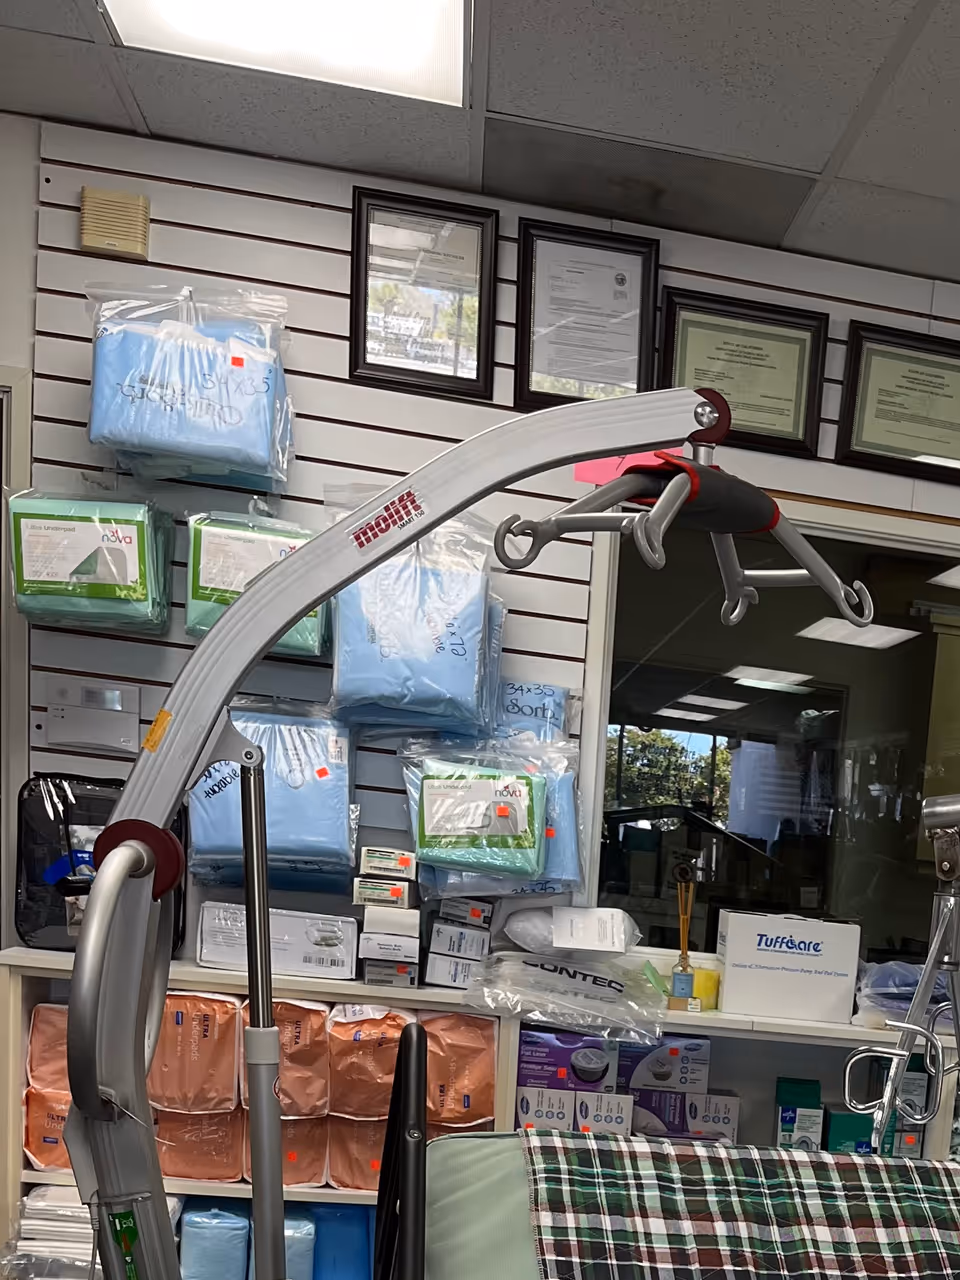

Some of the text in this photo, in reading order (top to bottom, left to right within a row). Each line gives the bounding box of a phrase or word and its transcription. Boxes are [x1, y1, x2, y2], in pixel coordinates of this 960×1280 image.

[352, 490, 422, 549] molift
[495, 788, 522, 798] nova
[756, 934, 822, 953] Tuffcare
[190, 1012, 210, 1061] ULTRA Underpads
[294, 1020, 302, 1046] ULTRA
[46, 1112, 66, 1122] ULTR
